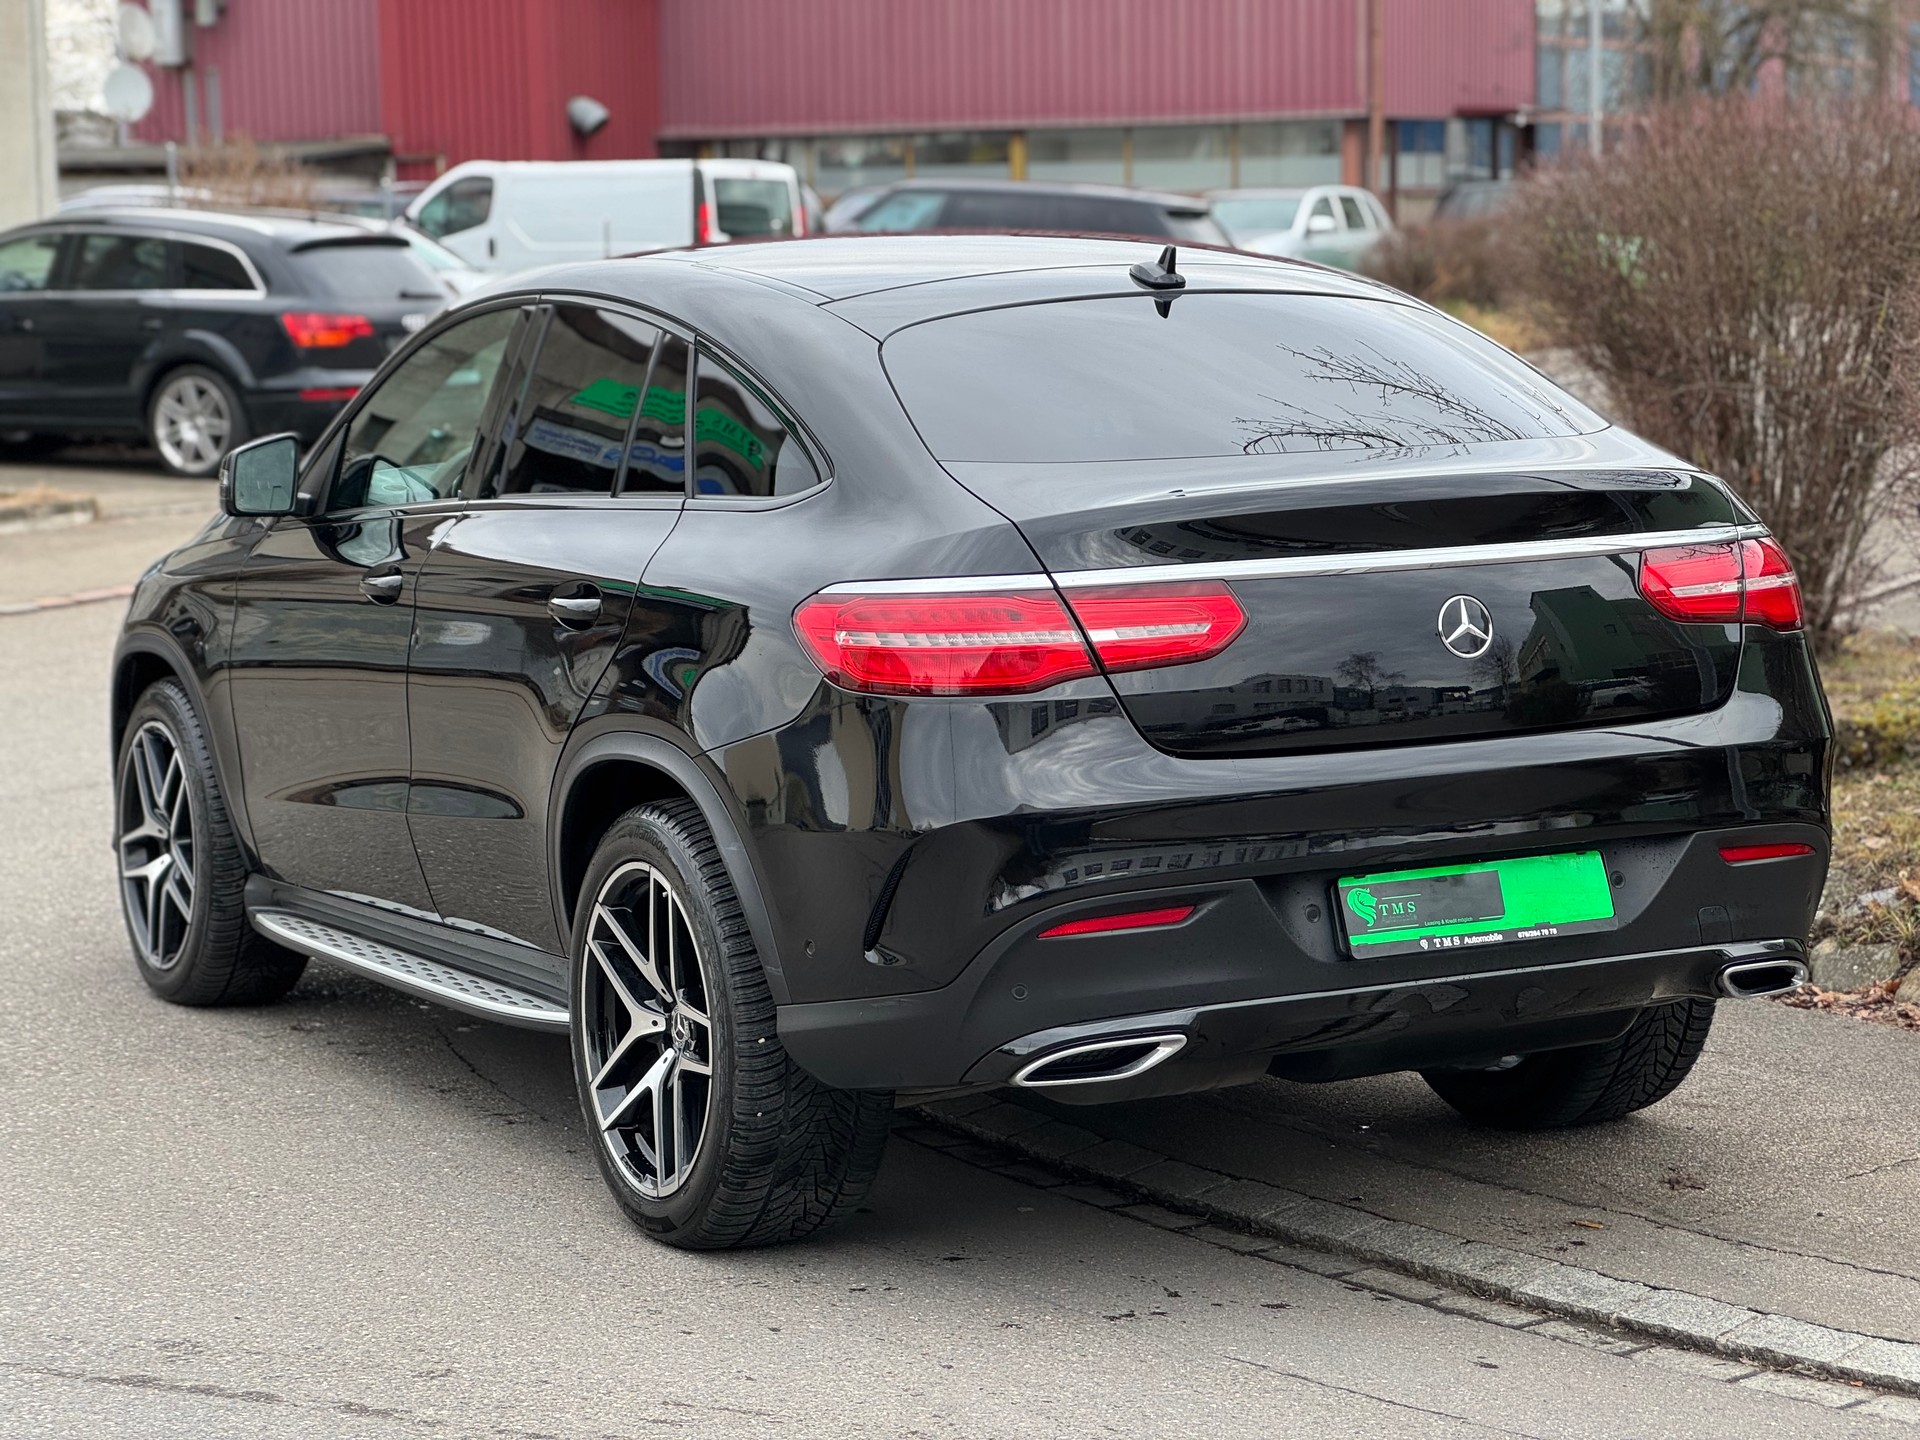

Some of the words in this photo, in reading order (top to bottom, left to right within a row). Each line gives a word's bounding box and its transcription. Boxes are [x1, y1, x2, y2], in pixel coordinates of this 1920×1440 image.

[1379, 901, 1416, 916] TMS
[1433, 936, 1461, 948] TMS
[1463, 933, 1503, 945] Automobile
